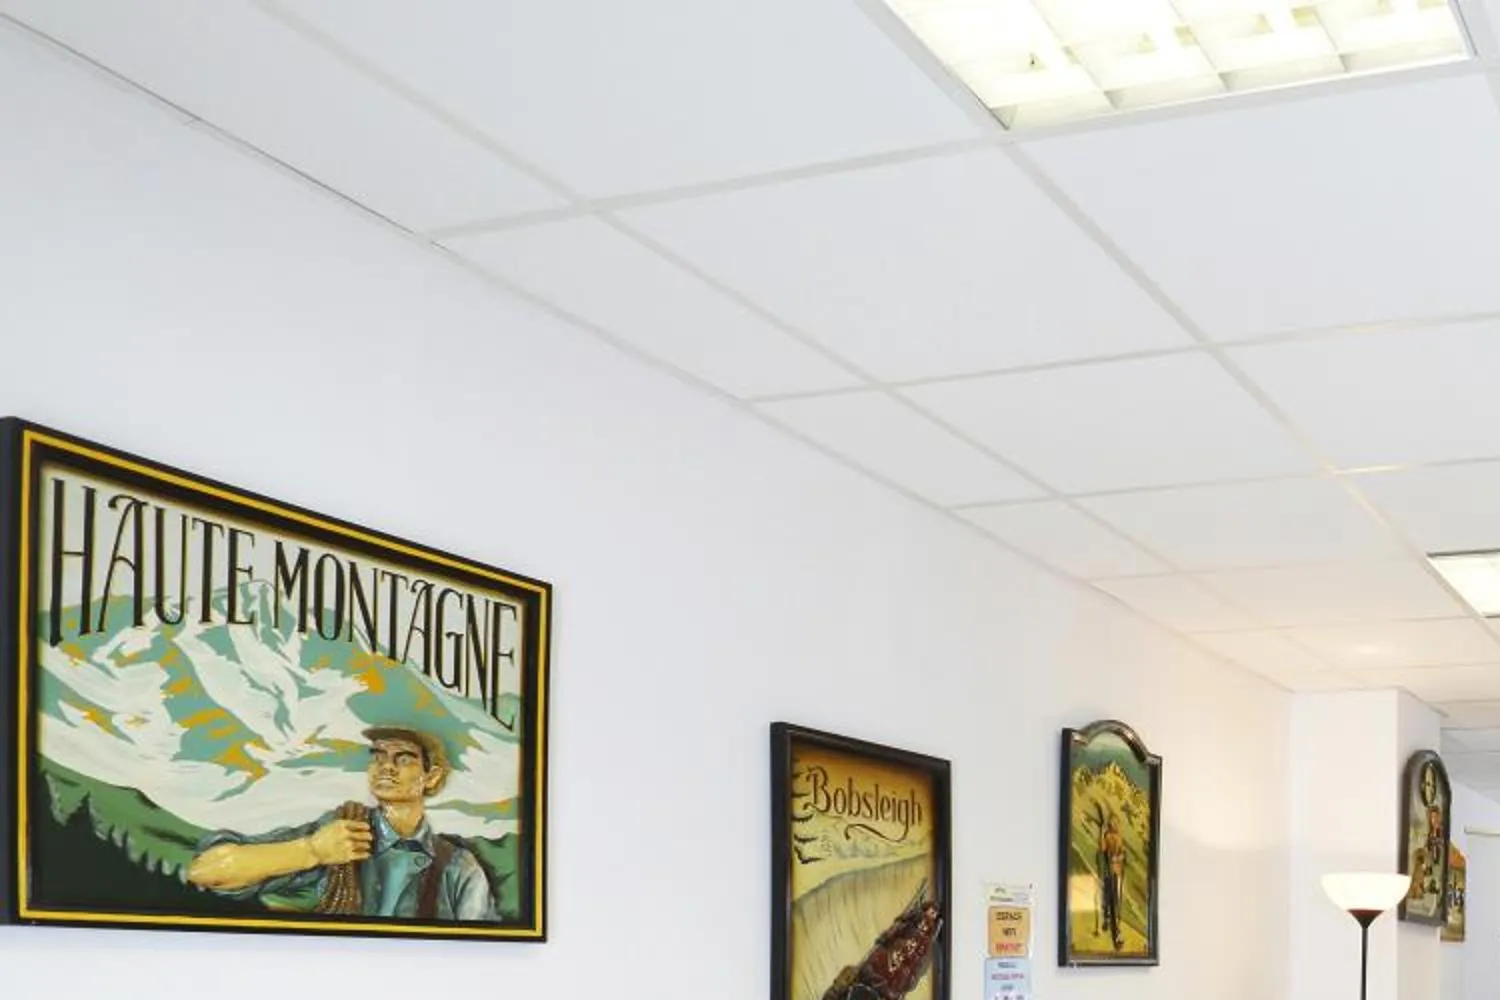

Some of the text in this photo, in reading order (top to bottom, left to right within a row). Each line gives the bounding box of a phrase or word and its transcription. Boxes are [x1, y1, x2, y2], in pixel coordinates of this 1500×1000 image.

[50, 478, 518, 732] HAUTE MONTAGNE
[803, 765, 923, 843] Bobsleigh
